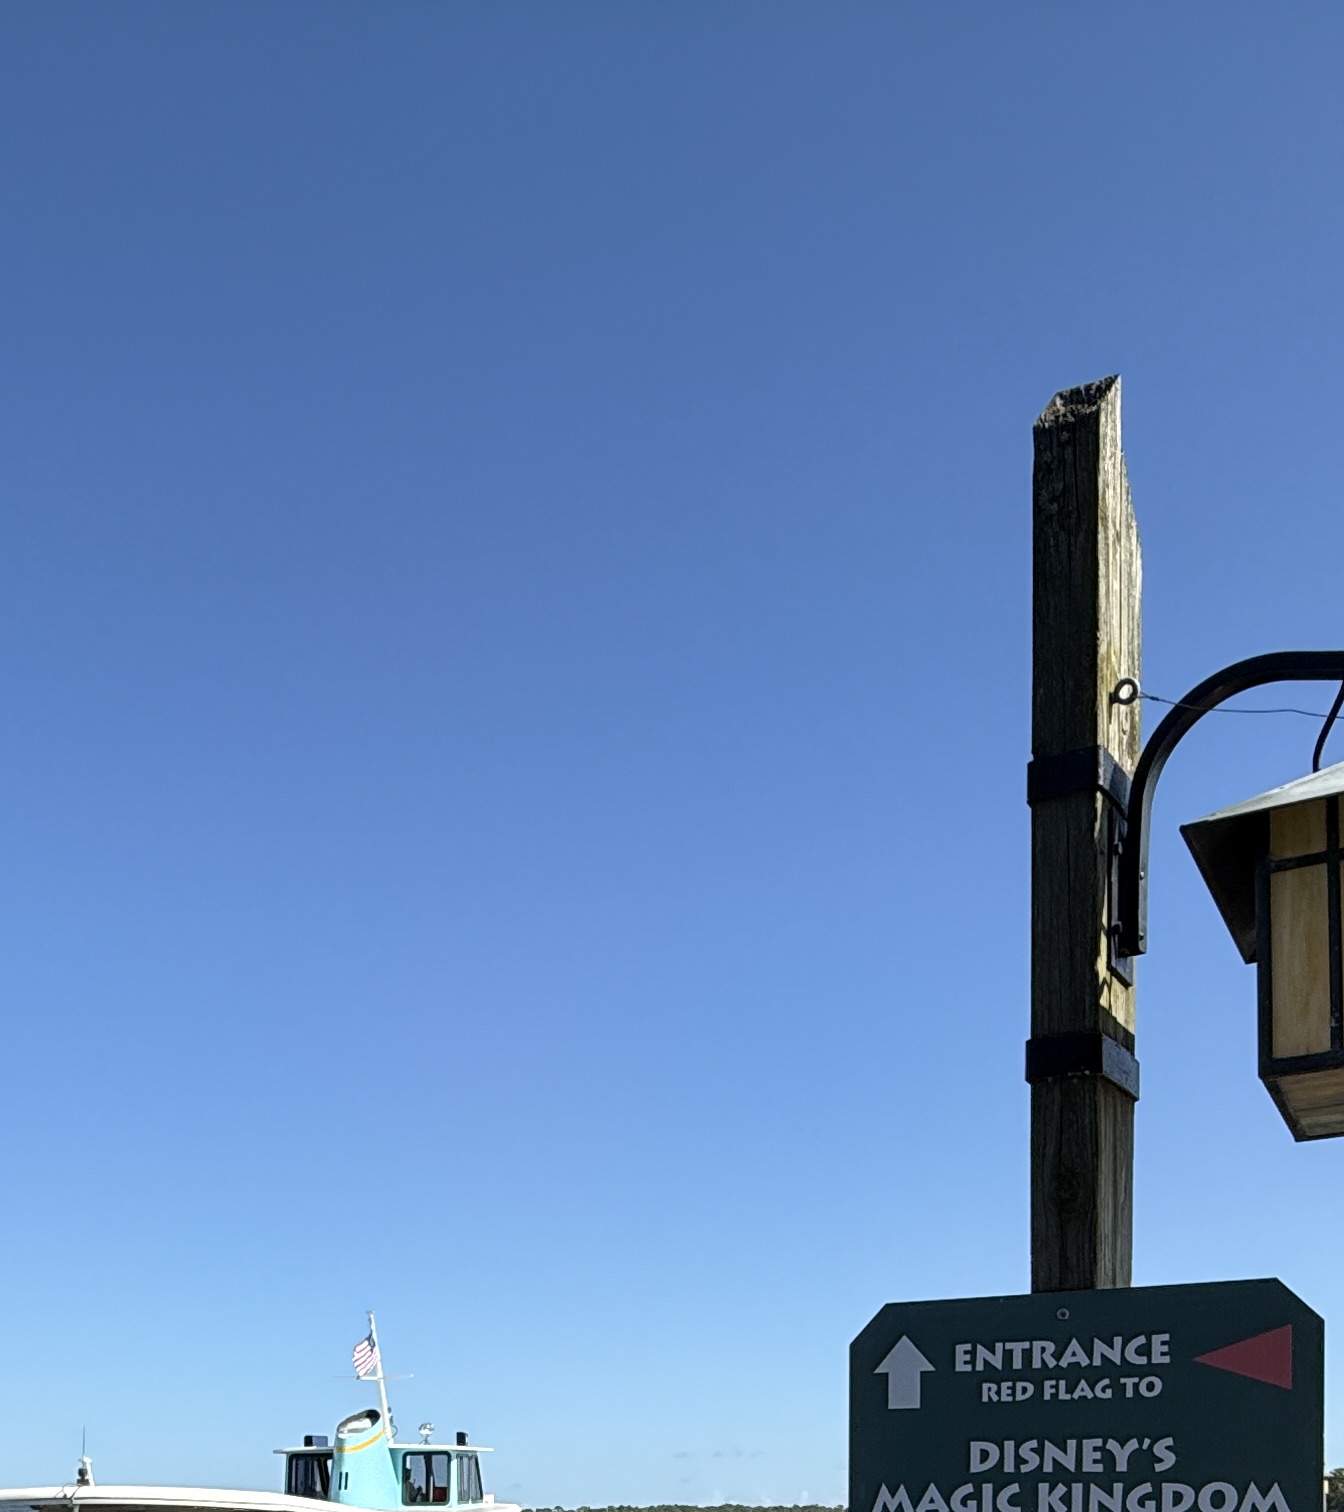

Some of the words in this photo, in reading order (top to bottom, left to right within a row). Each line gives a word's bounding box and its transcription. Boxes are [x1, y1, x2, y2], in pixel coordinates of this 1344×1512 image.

[955, 1334, 1170, 1371] ENTRANCE
[982, 1382, 1034, 1402] RED
[1044, 1378, 1112, 1400] FLAG
[1120, 1376, 1162, 1397] TO
[970, 1437, 1176, 1473] DISNEY'S
